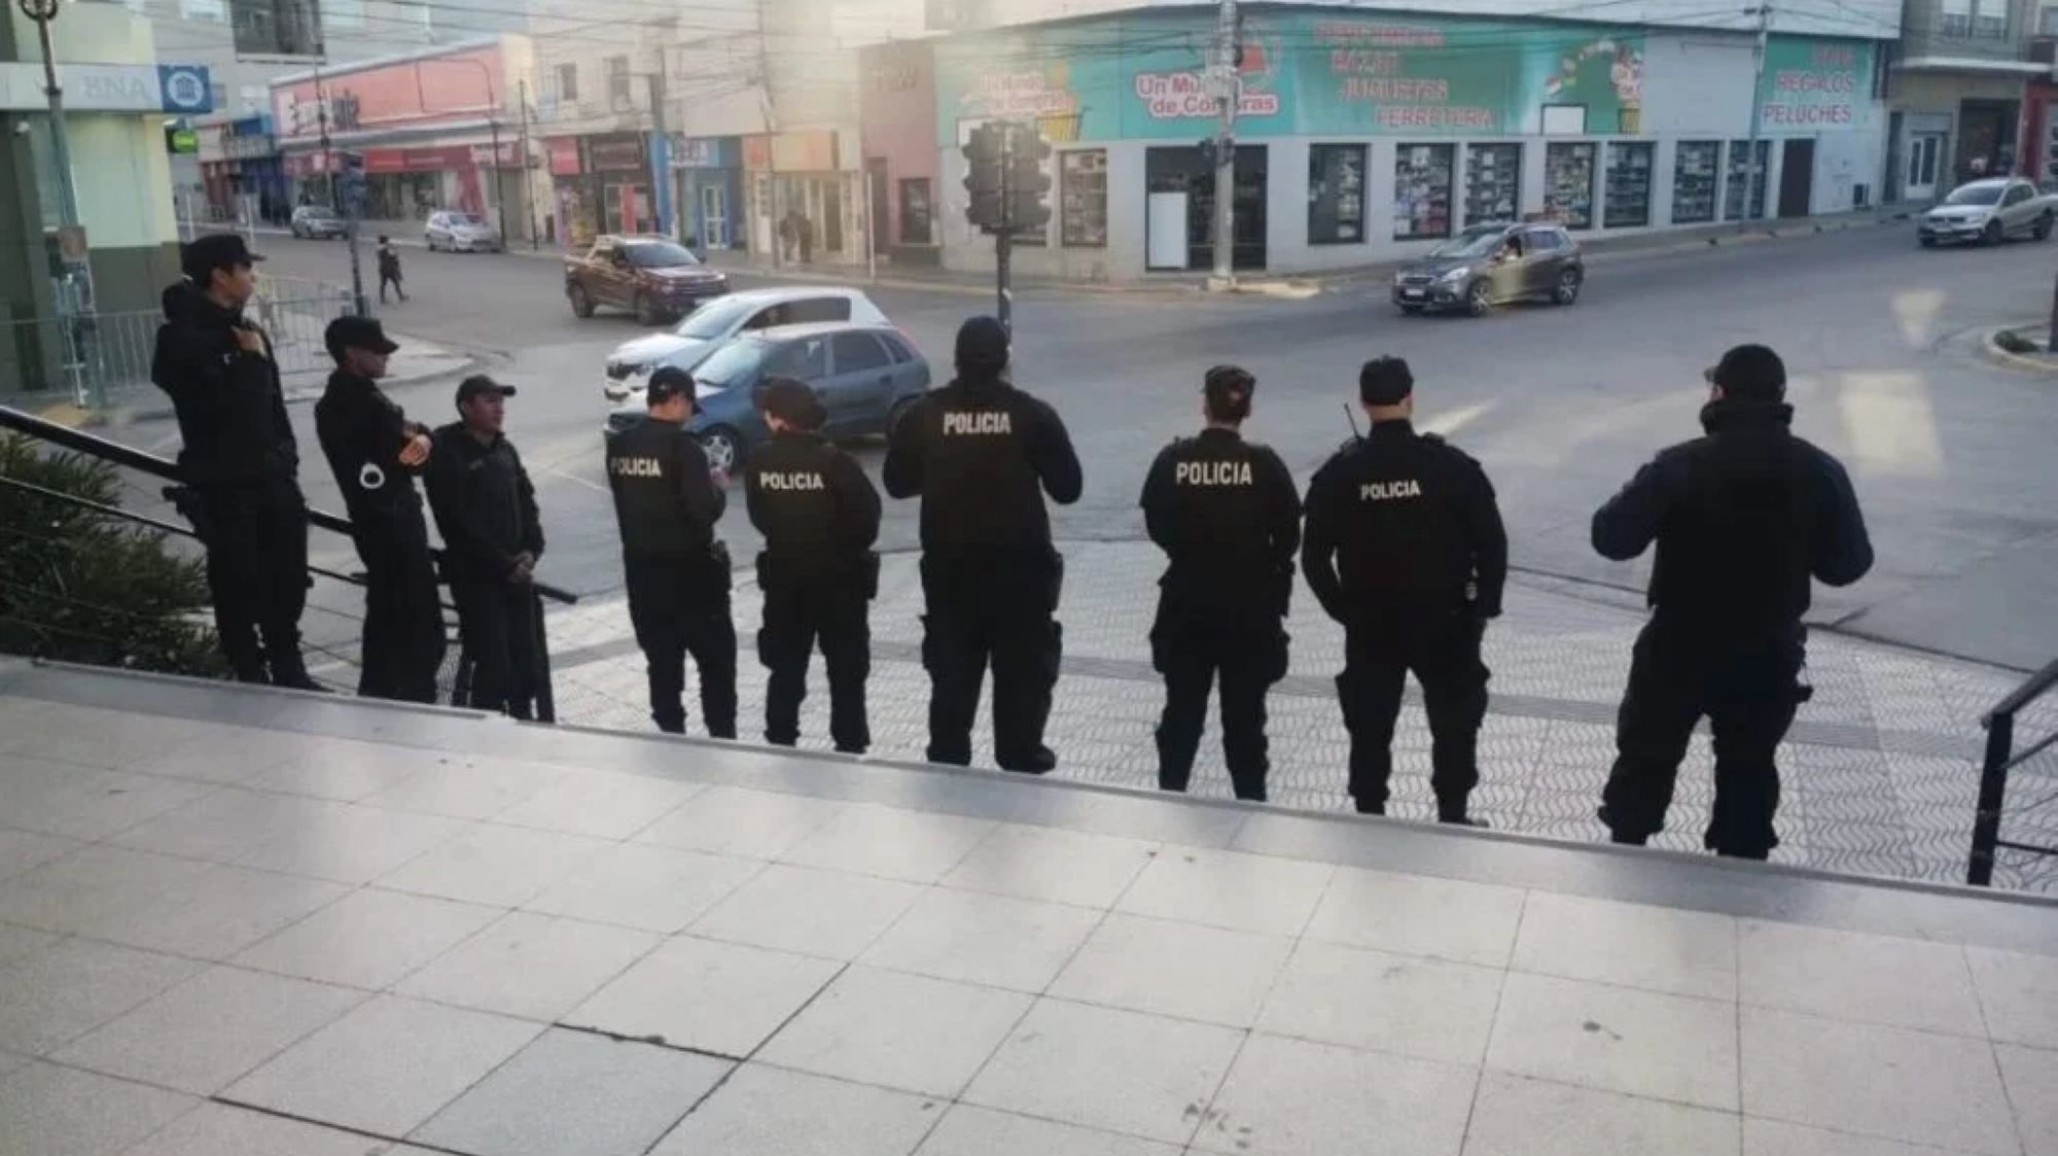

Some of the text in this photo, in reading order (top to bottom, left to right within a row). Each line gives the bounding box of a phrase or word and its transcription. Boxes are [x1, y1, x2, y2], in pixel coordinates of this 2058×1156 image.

[83, 75, 147, 100] BNA
[1140, 79, 1166, 98] Un
[1776, 73, 1853, 93] REGALOS
[1153, 98, 1178, 113] de
[1763, 103, 1851, 124] PELUCHES
[943, 412, 1011, 435] POLICIA
[610, 457, 662, 478] POLICIA
[1176, 461, 1252, 486] POLICIA
[760, 472, 825, 490] POLICIA
[1361, 479, 1421, 500] POLICIA
